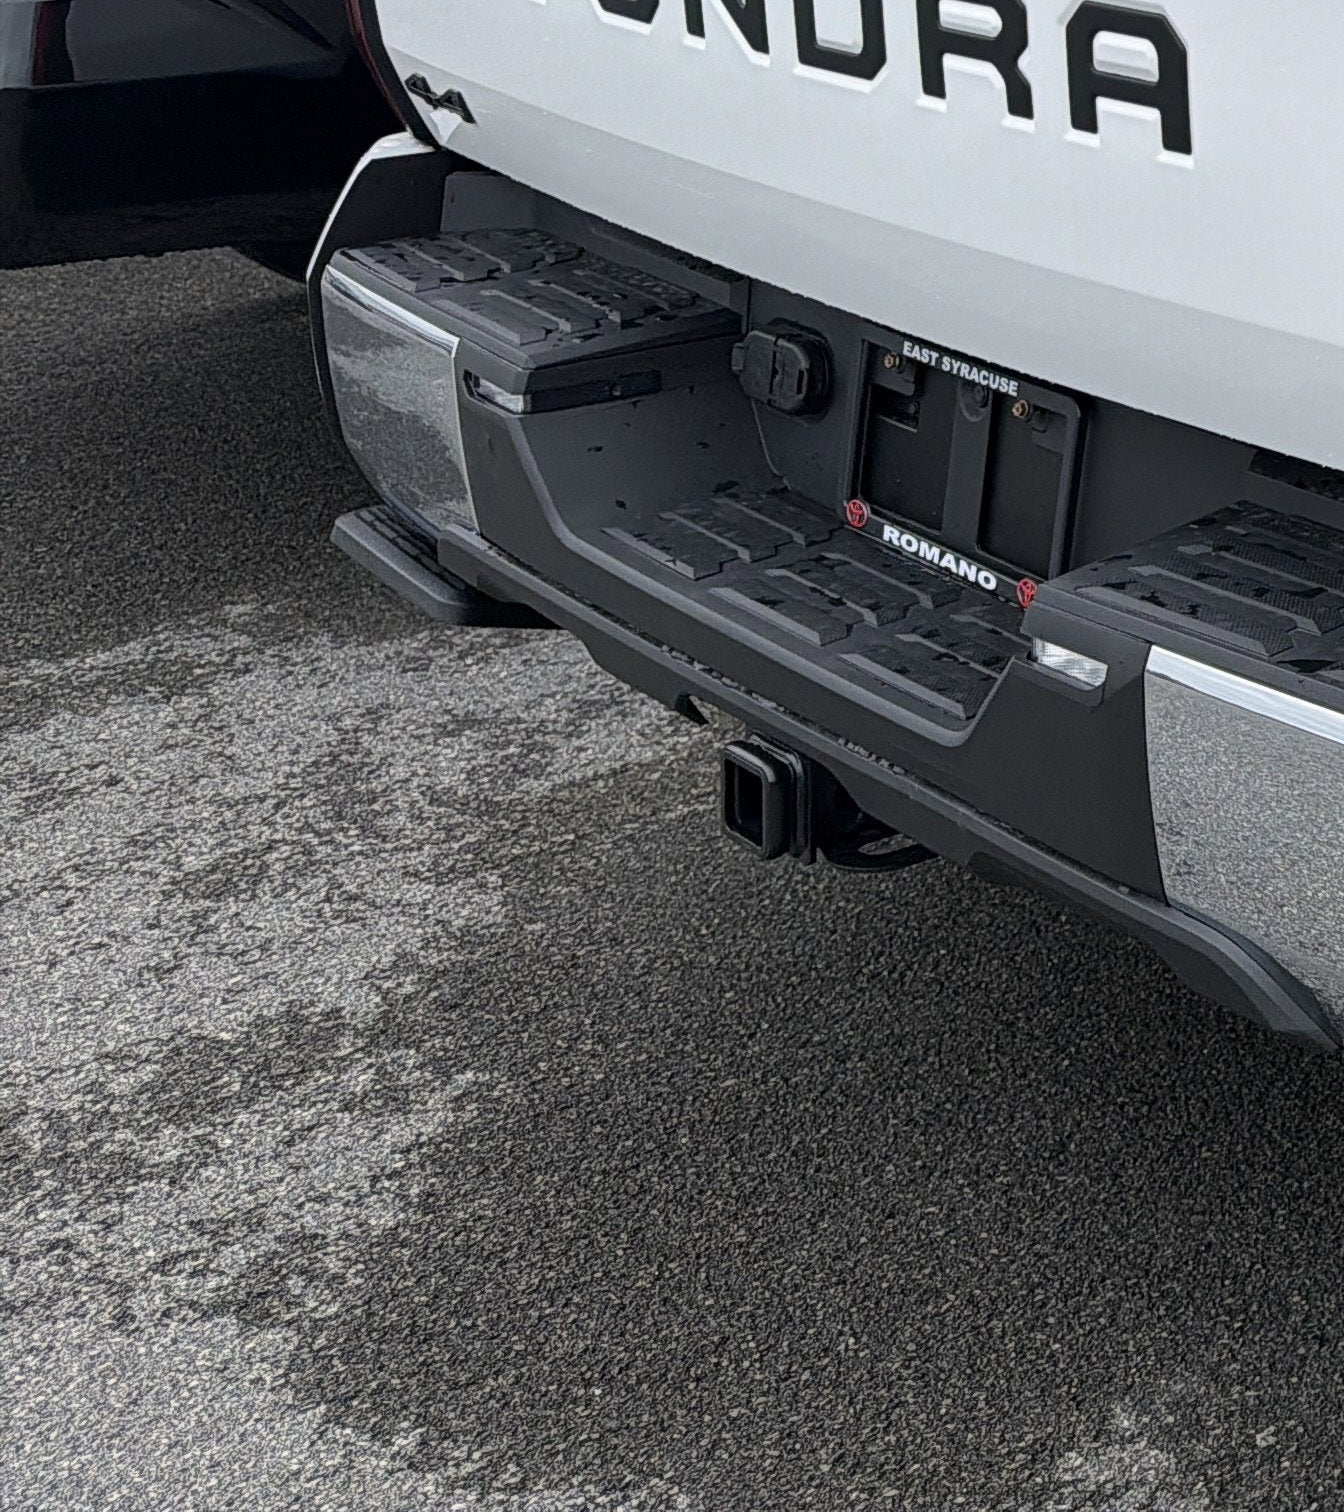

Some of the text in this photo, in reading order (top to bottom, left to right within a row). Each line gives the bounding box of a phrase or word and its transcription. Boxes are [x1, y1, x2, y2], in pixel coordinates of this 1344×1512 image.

[902, 340, 1019, 397] EAST SYRACUSE
[882, 524, 998, 591] ROMANO
